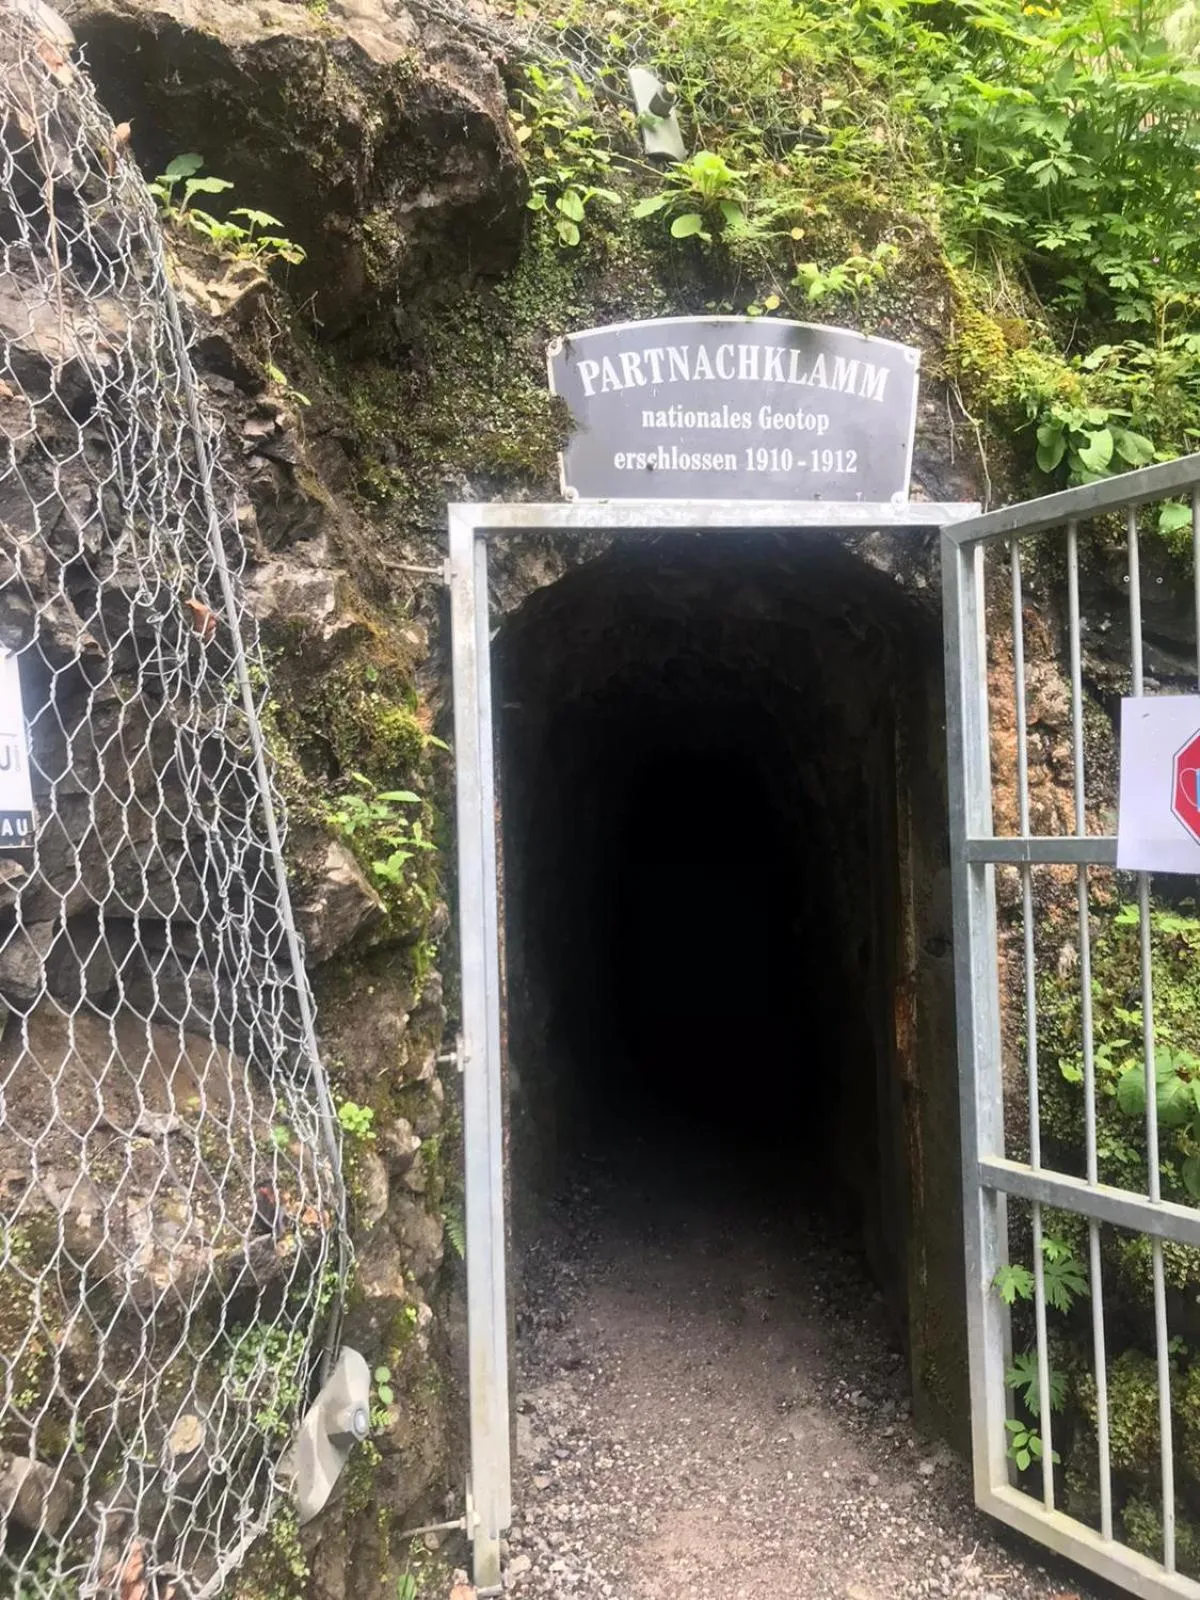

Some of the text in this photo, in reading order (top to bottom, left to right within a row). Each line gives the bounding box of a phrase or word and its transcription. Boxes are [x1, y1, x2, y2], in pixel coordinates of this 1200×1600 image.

[576, 343, 891, 402] PARTNACHKLAMM
[641, 404, 830, 435] nationales Geotop
[613, 445, 737, 471] erschlossen
